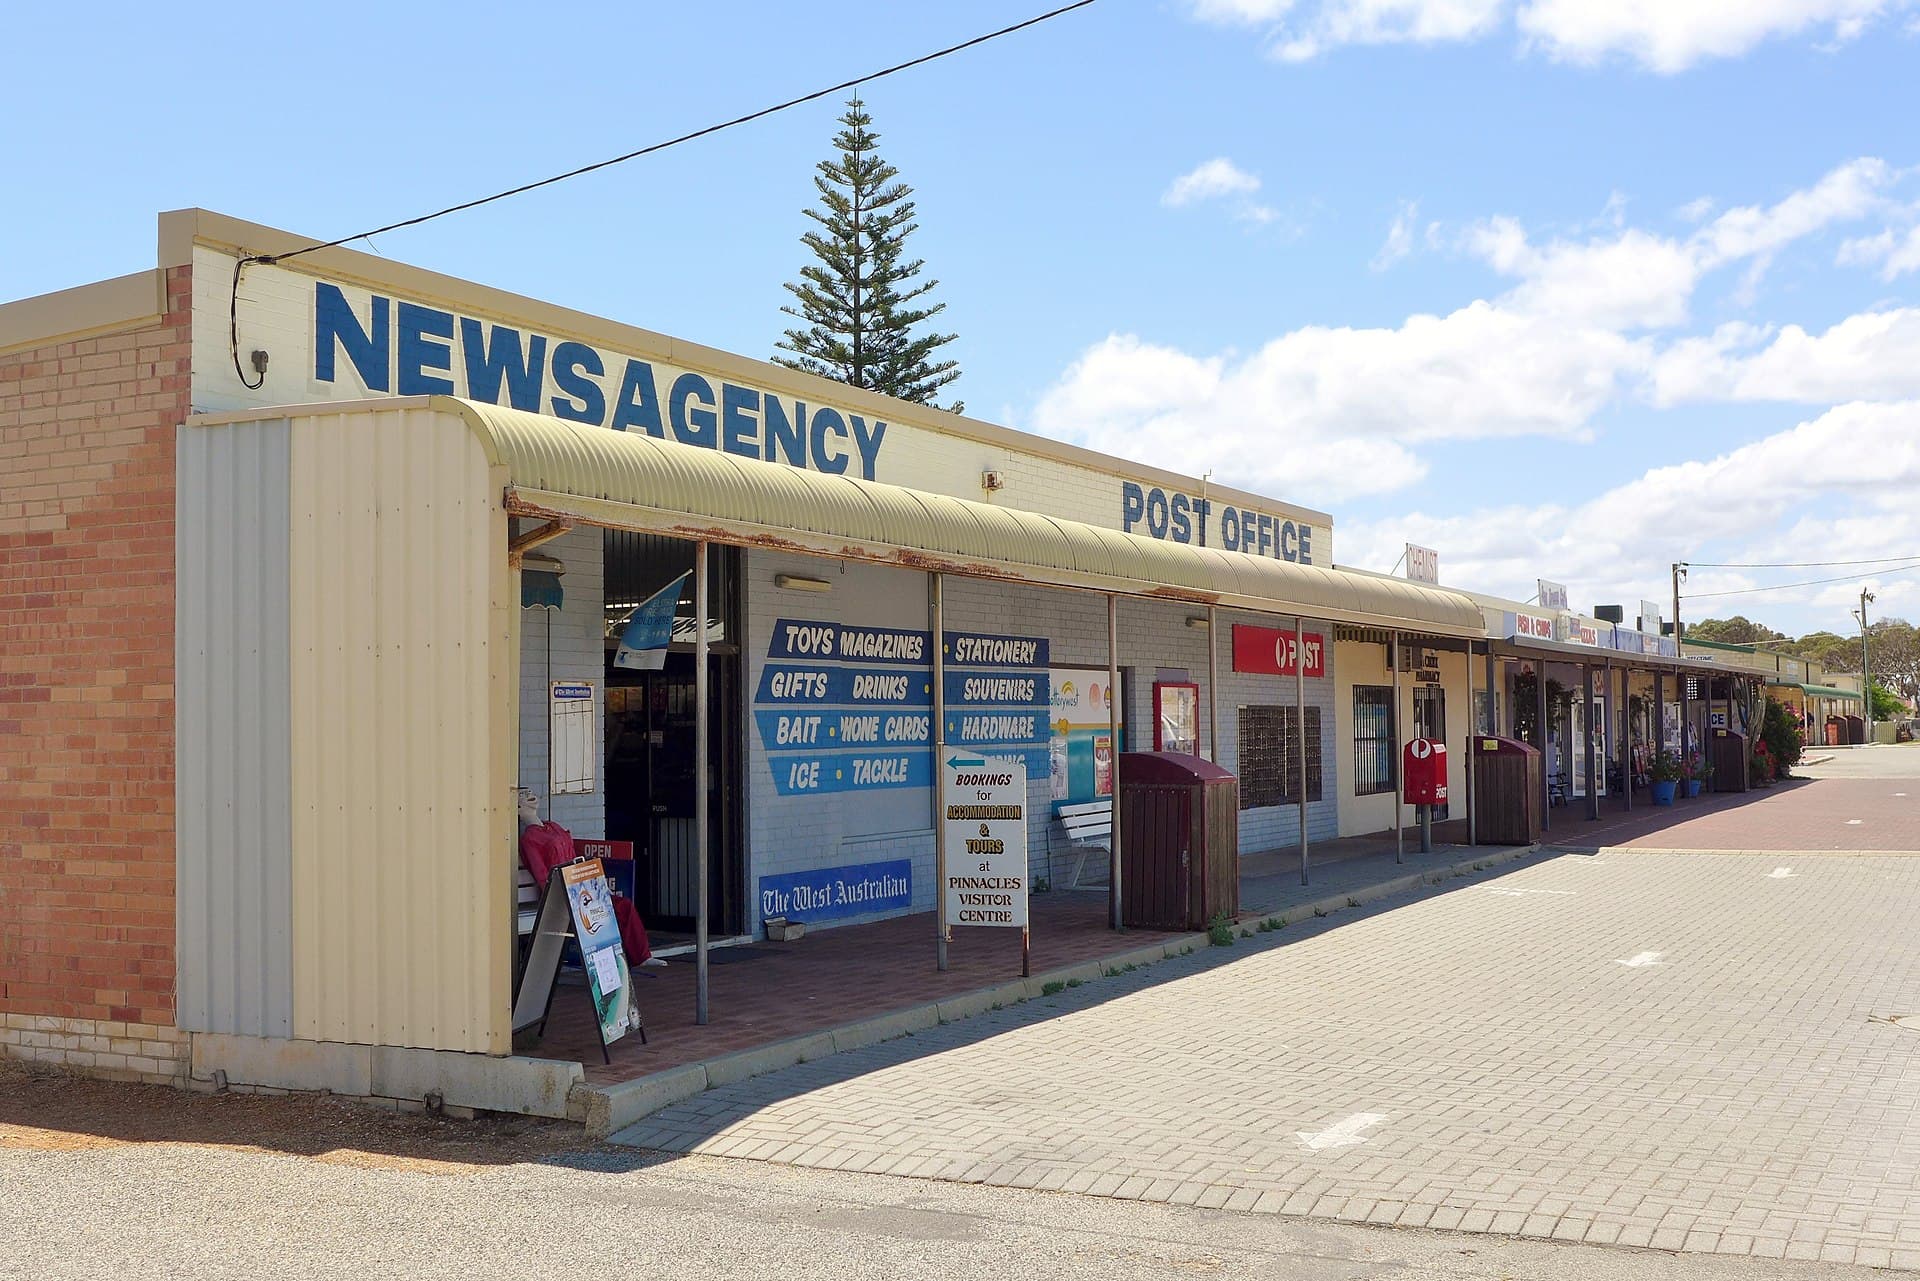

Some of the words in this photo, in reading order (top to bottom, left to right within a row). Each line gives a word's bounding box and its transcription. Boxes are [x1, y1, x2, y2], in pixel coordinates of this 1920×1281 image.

[315, 281, 887, 481] NEWSAGENCY
[1122, 481, 1211, 548] POST
[1221, 506, 1312, 566] OFFICE
[786, 625, 834, 655] TOYS
[840, 631, 924, 660] MAGAZINES
[955, 637, 1037, 664] STATIONERY
[771, 671, 828, 698] GIFTS
[853, 675, 909, 700] DRINKS
[963, 678, 1035, 701] SOUVENIRS
[1050, 686, 1080, 711] otterywest
[776, 716, 822, 745] BAIT
[841, 716, 880, 742] HONE
[884, 716, 929, 742] CARDS
[961, 716, 1035, 740] HARDWARE
[788, 761, 820, 789] ICE
[853, 758, 909, 785] TACKLE
[955, 774, 1012, 786] BOOKINGS
[976, 789, 992, 801] for
[1436, 787, 1447, 798] POST
[947, 805, 1022, 820] ACCOMMODATION
[979, 823, 990, 837] &
[584, 843, 612, 858] OPEN
[966, 839, 1004, 854] TOURS
[979, 860, 991, 872] at
[949, 877, 1022, 890] PINNACLES
[763, 889, 790, 916] The
[793, 883, 832, 912] West
[834, 874, 908, 905] Australian
[959, 893, 1013, 906] VISITOR
[959, 909, 1013, 923] CENTRE
